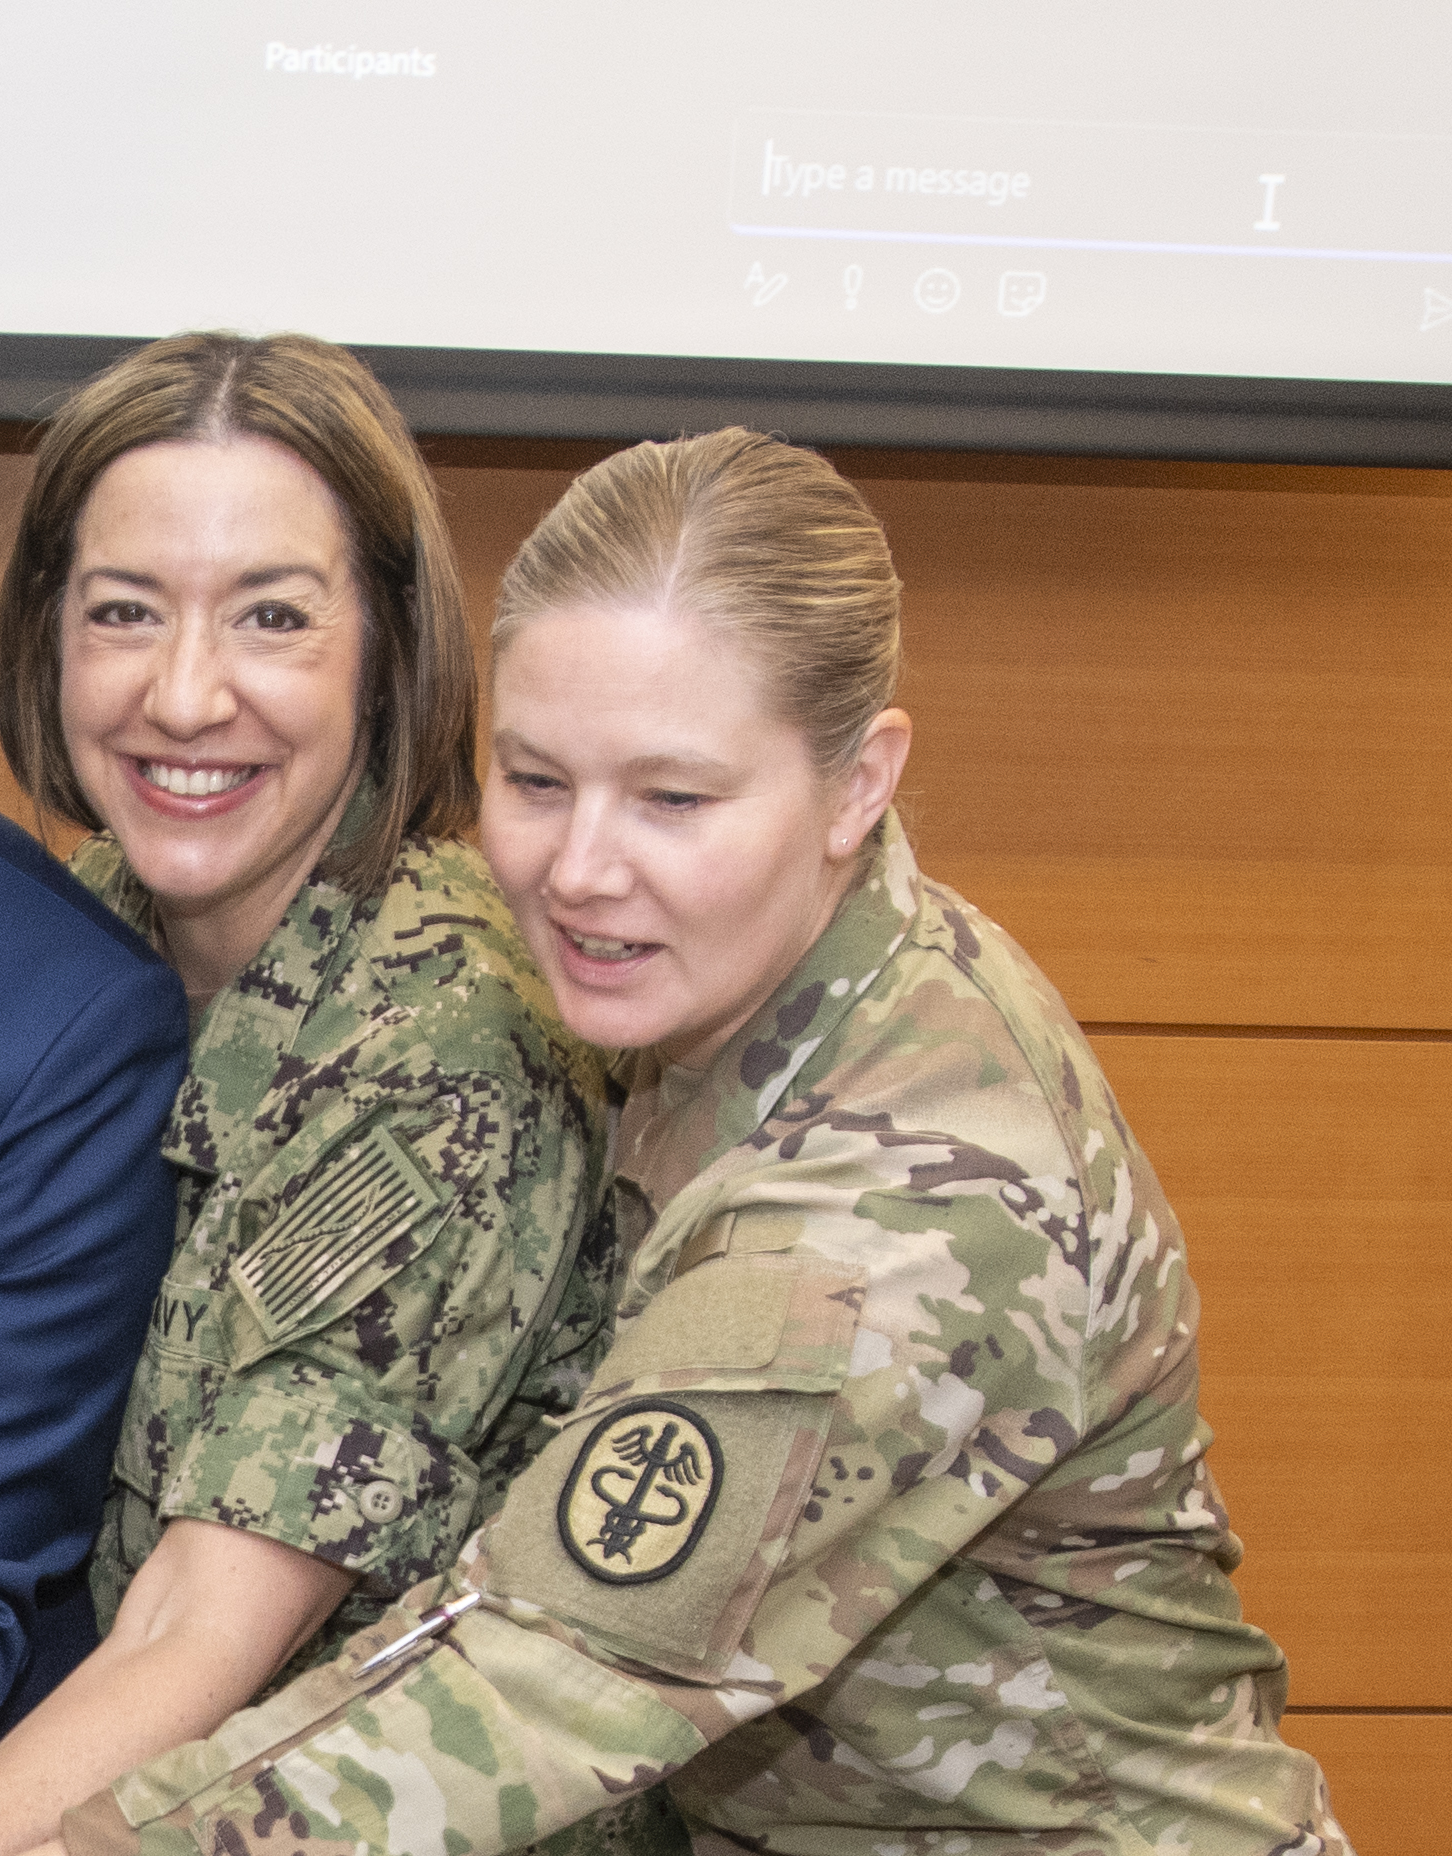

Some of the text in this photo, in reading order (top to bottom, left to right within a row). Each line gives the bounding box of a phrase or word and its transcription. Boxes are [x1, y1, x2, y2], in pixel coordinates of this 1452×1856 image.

[265, 41, 437, 80] Participants
[770, 154, 1031, 206] Type a message
